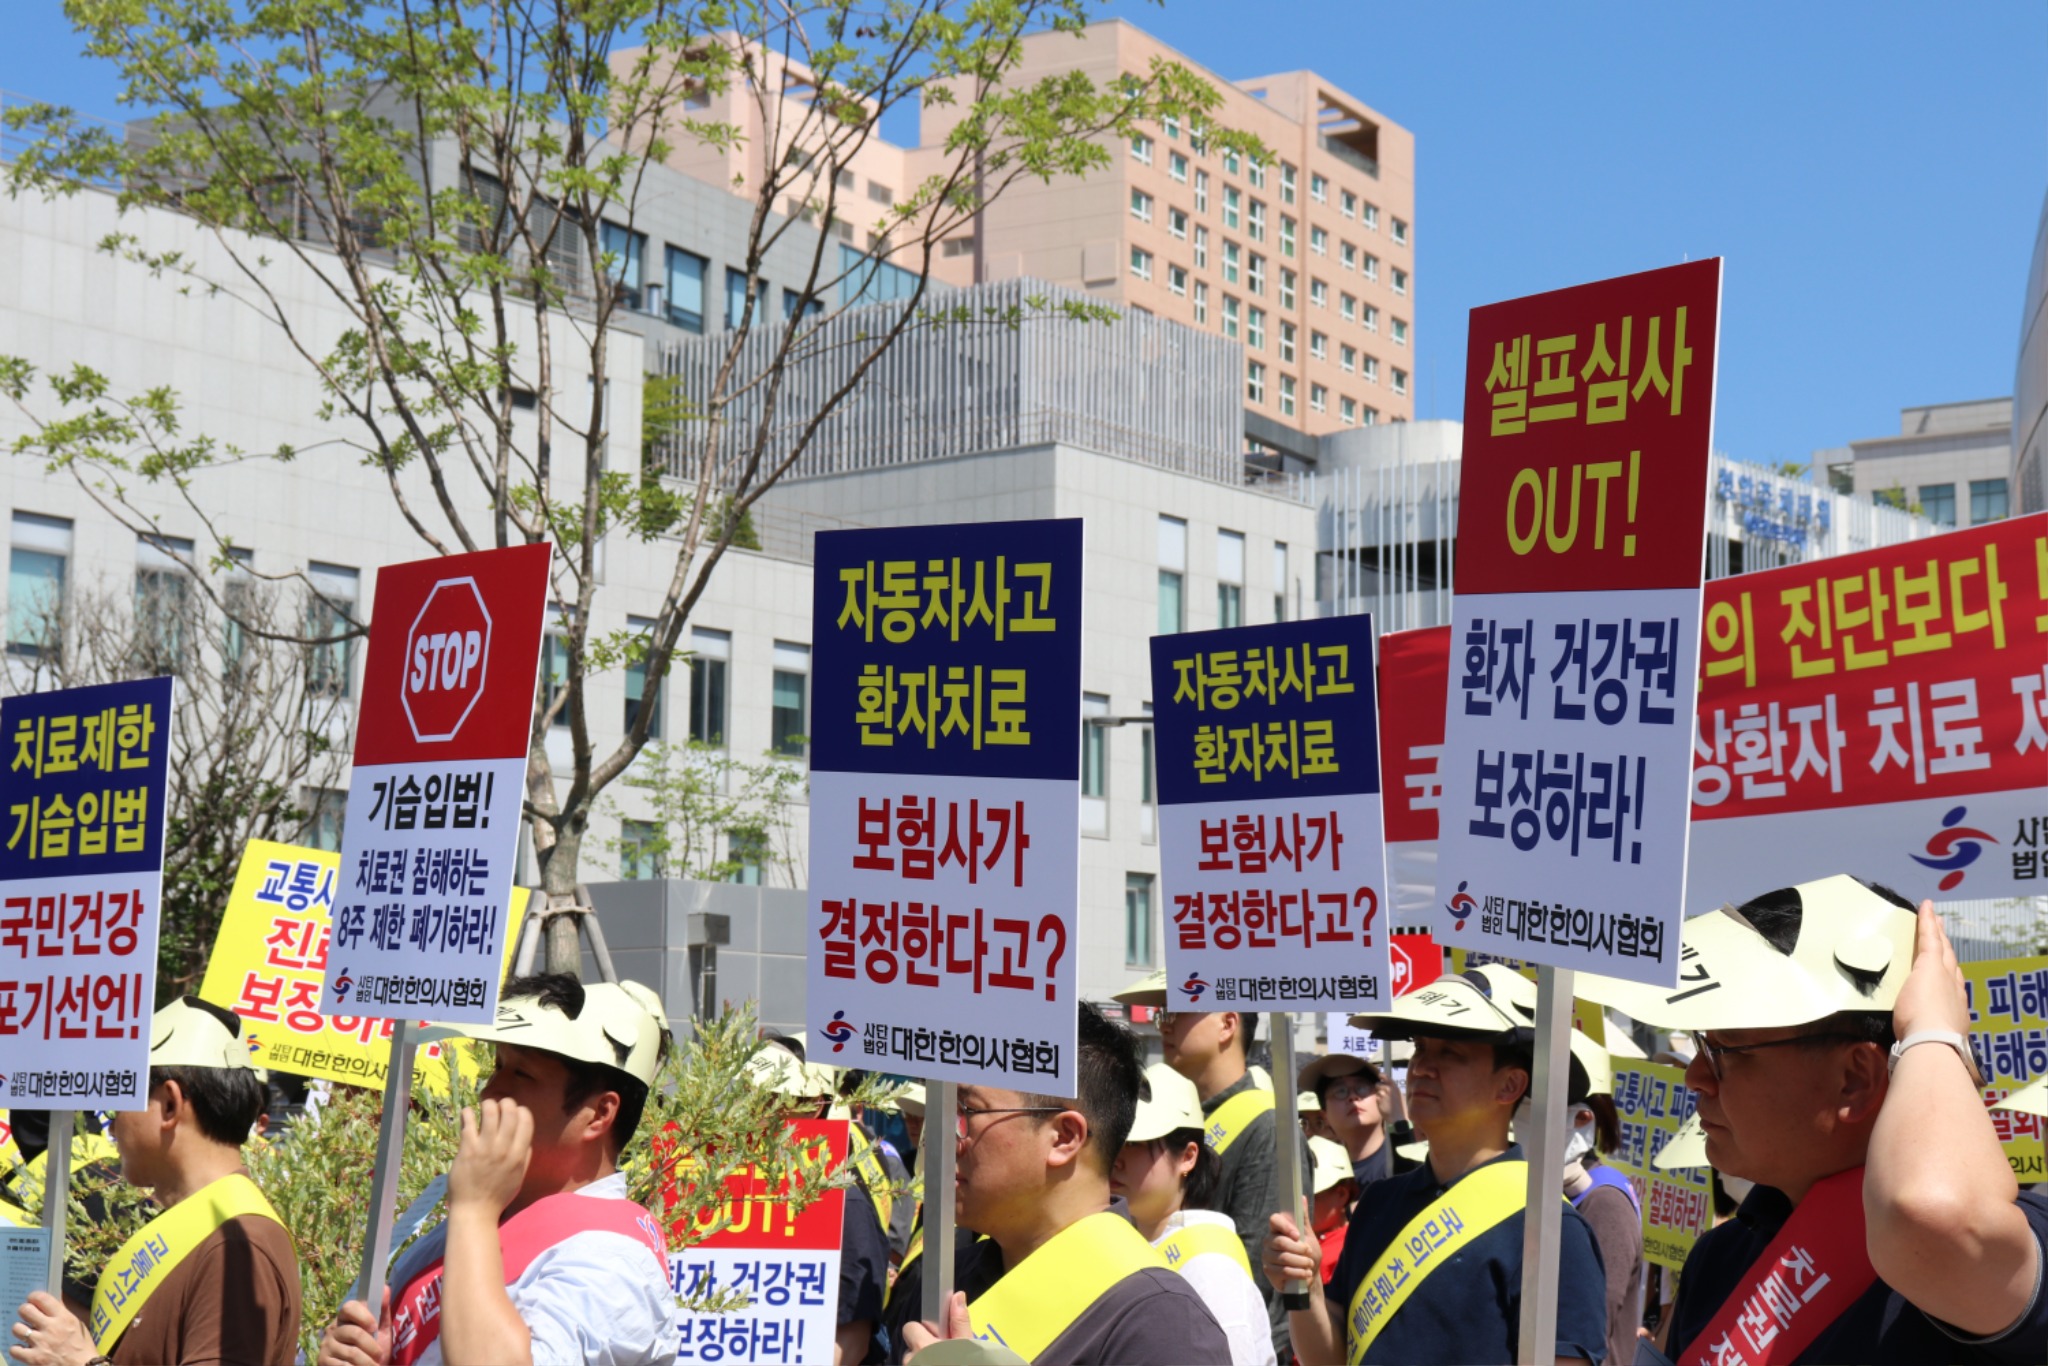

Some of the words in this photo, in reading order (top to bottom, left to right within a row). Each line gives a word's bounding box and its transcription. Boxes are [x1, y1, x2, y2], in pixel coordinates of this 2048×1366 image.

[1484, 305, 1693, 437] 셀프심사
[1507, 451, 1640, 556] OUT!
[837, 556, 1056, 643] 자동차사고
[1698, 590, 1757, 688] 의
[1778, 540, 2009, 682] 진단보다
[410, 630, 482, 694] STOP
[1173, 643, 1354, 710] 자동차사고
[1462, 619, 1535, 720] 환자
[1551, 618, 1678, 725] 건강권
[856, 665, 1030, 750] 환자치료
[1866, 675, 1994, 787] 치료
[11, 704, 155, 778] 치료제한
[1194, 720, 1339, 783] 환자치료
[7, 787, 147, 859] 기습입법
[369, 772, 494, 830] 기습입법!
[1469, 750, 1645, 864] 보장하라!
[356, 849, 407, 895] 치료권
[413, 848, 488, 896] 침해하는
[853, 795, 1029, 887] 보험사가
[1199, 811, 1343, 873] 보험사가
[1, 889, 144, 958] 국민건강
[338, 906, 365, 949] 8주
[370, 904, 405, 950] 제한
[409, 904, 496, 955] 폐기하라!
[819, 898, 1066, 1001] 결정한다고?
[1174, 887, 1377, 949] 결정한다고?
[1507, 899, 1664, 964] 대한한의사협회
[374, 976, 486, 1008] 대한한의사협회
[1239, 975, 1377, 1001] 대한한의사협회
[29, 1070, 136, 1097] 대한한의사협회
[292, 1047, 427, 1087] 대한한의사회
[891, 1026, 1059, 1079] 대한한의사협회
[1613, 1072, 1667, 1118] 교통사고
[1608, 1122, 1643, 1168] 료권
[1404, 1207, 1465, 1268] 국민의
[104, 1233, 169, 1314] 교통사고
[1737, 1245, 1832, 1355] 치료권
